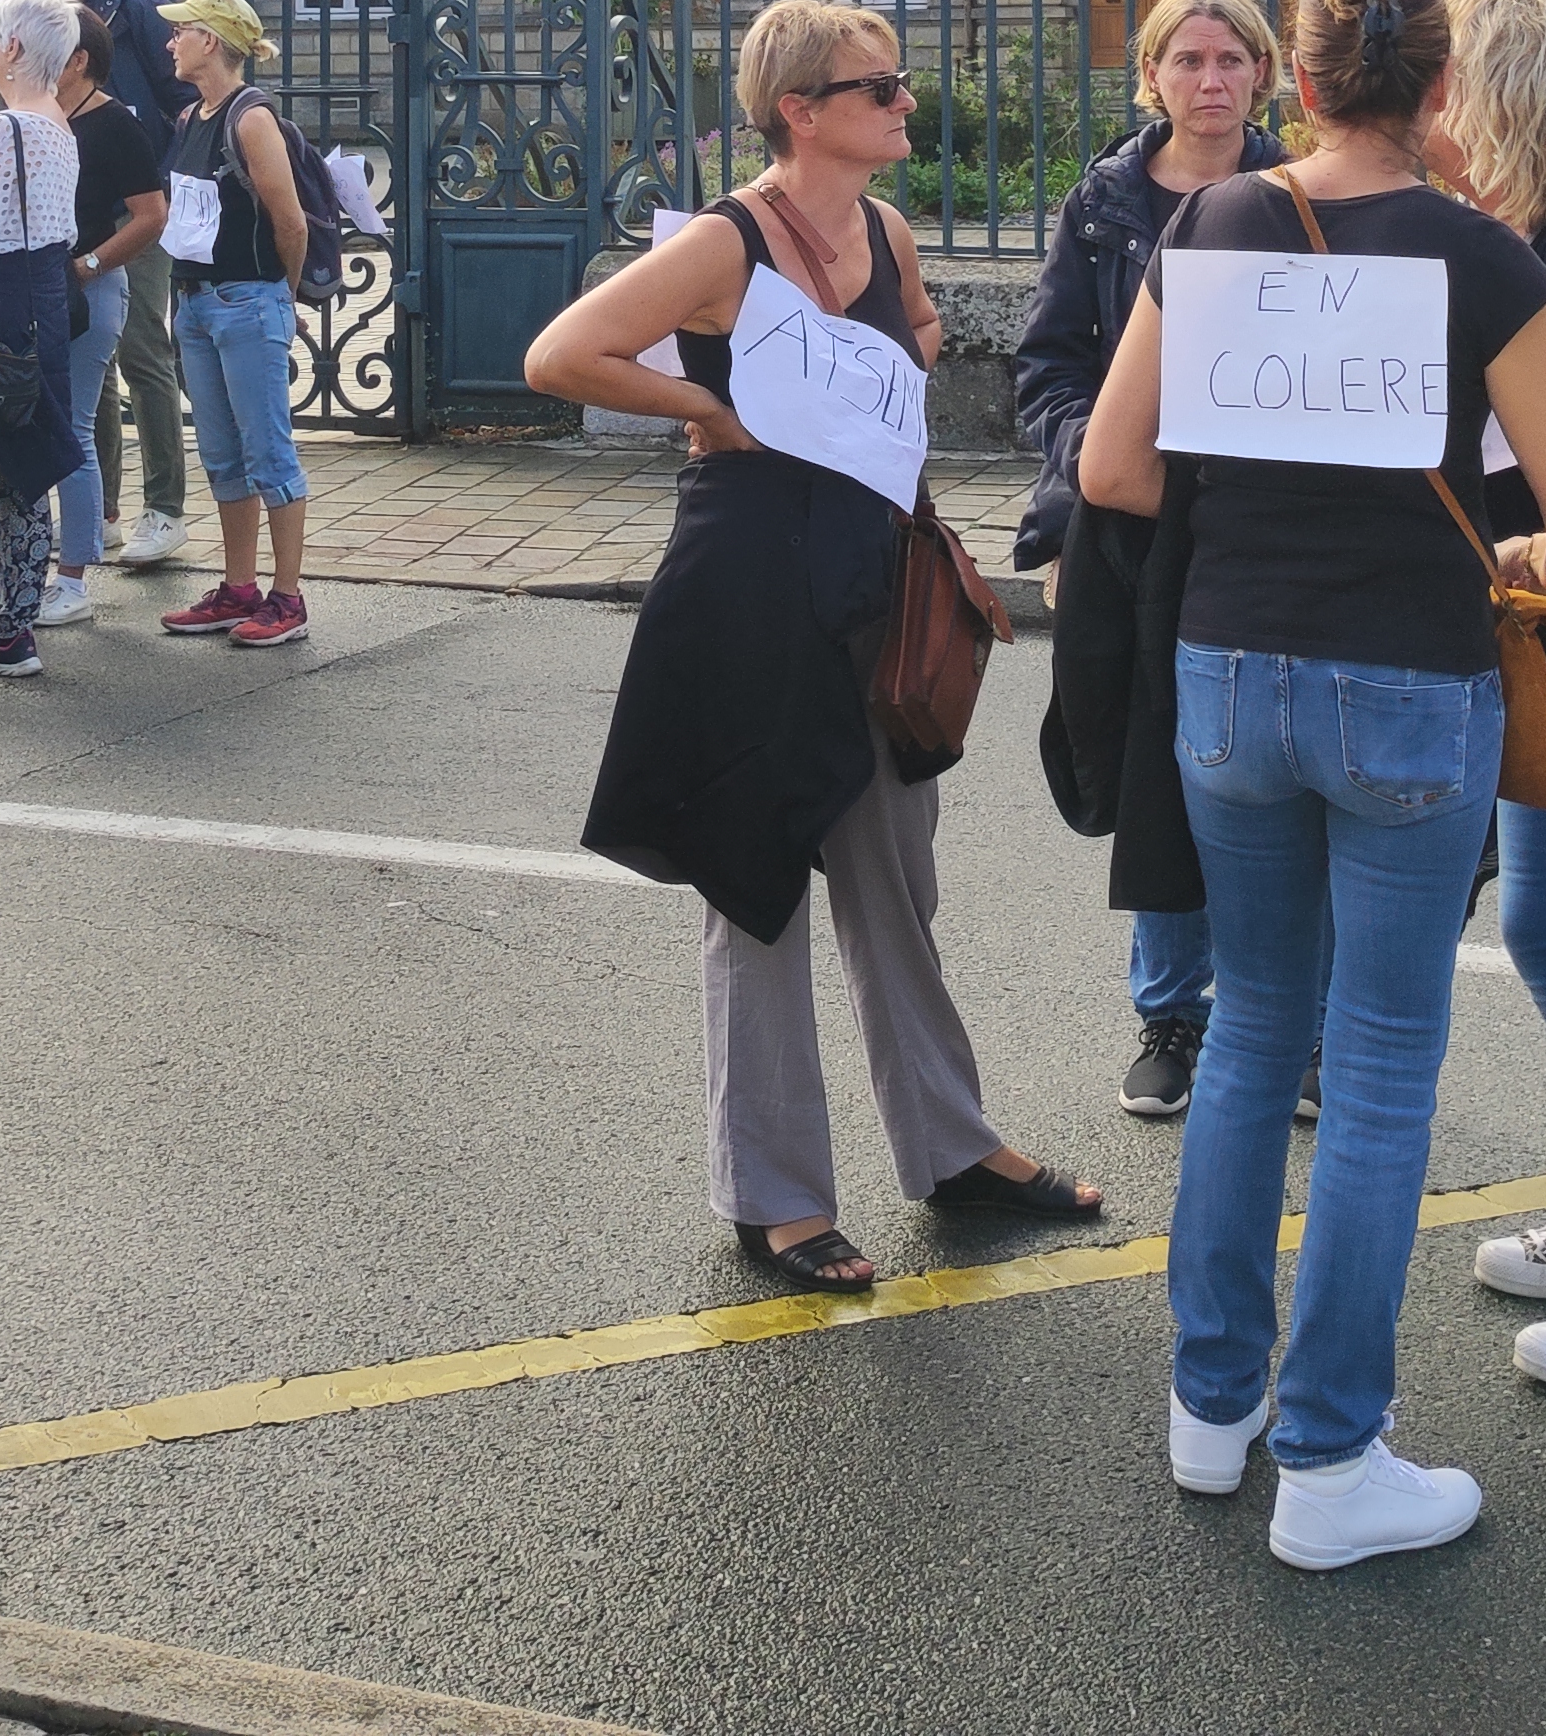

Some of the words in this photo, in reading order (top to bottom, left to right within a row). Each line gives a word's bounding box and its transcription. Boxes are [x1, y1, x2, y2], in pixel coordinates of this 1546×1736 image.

[1257, 267, 1360, 313] EN
[742, 308, 923, 446] ATSEM
[1209, 350, 1449, 415] COLERE
